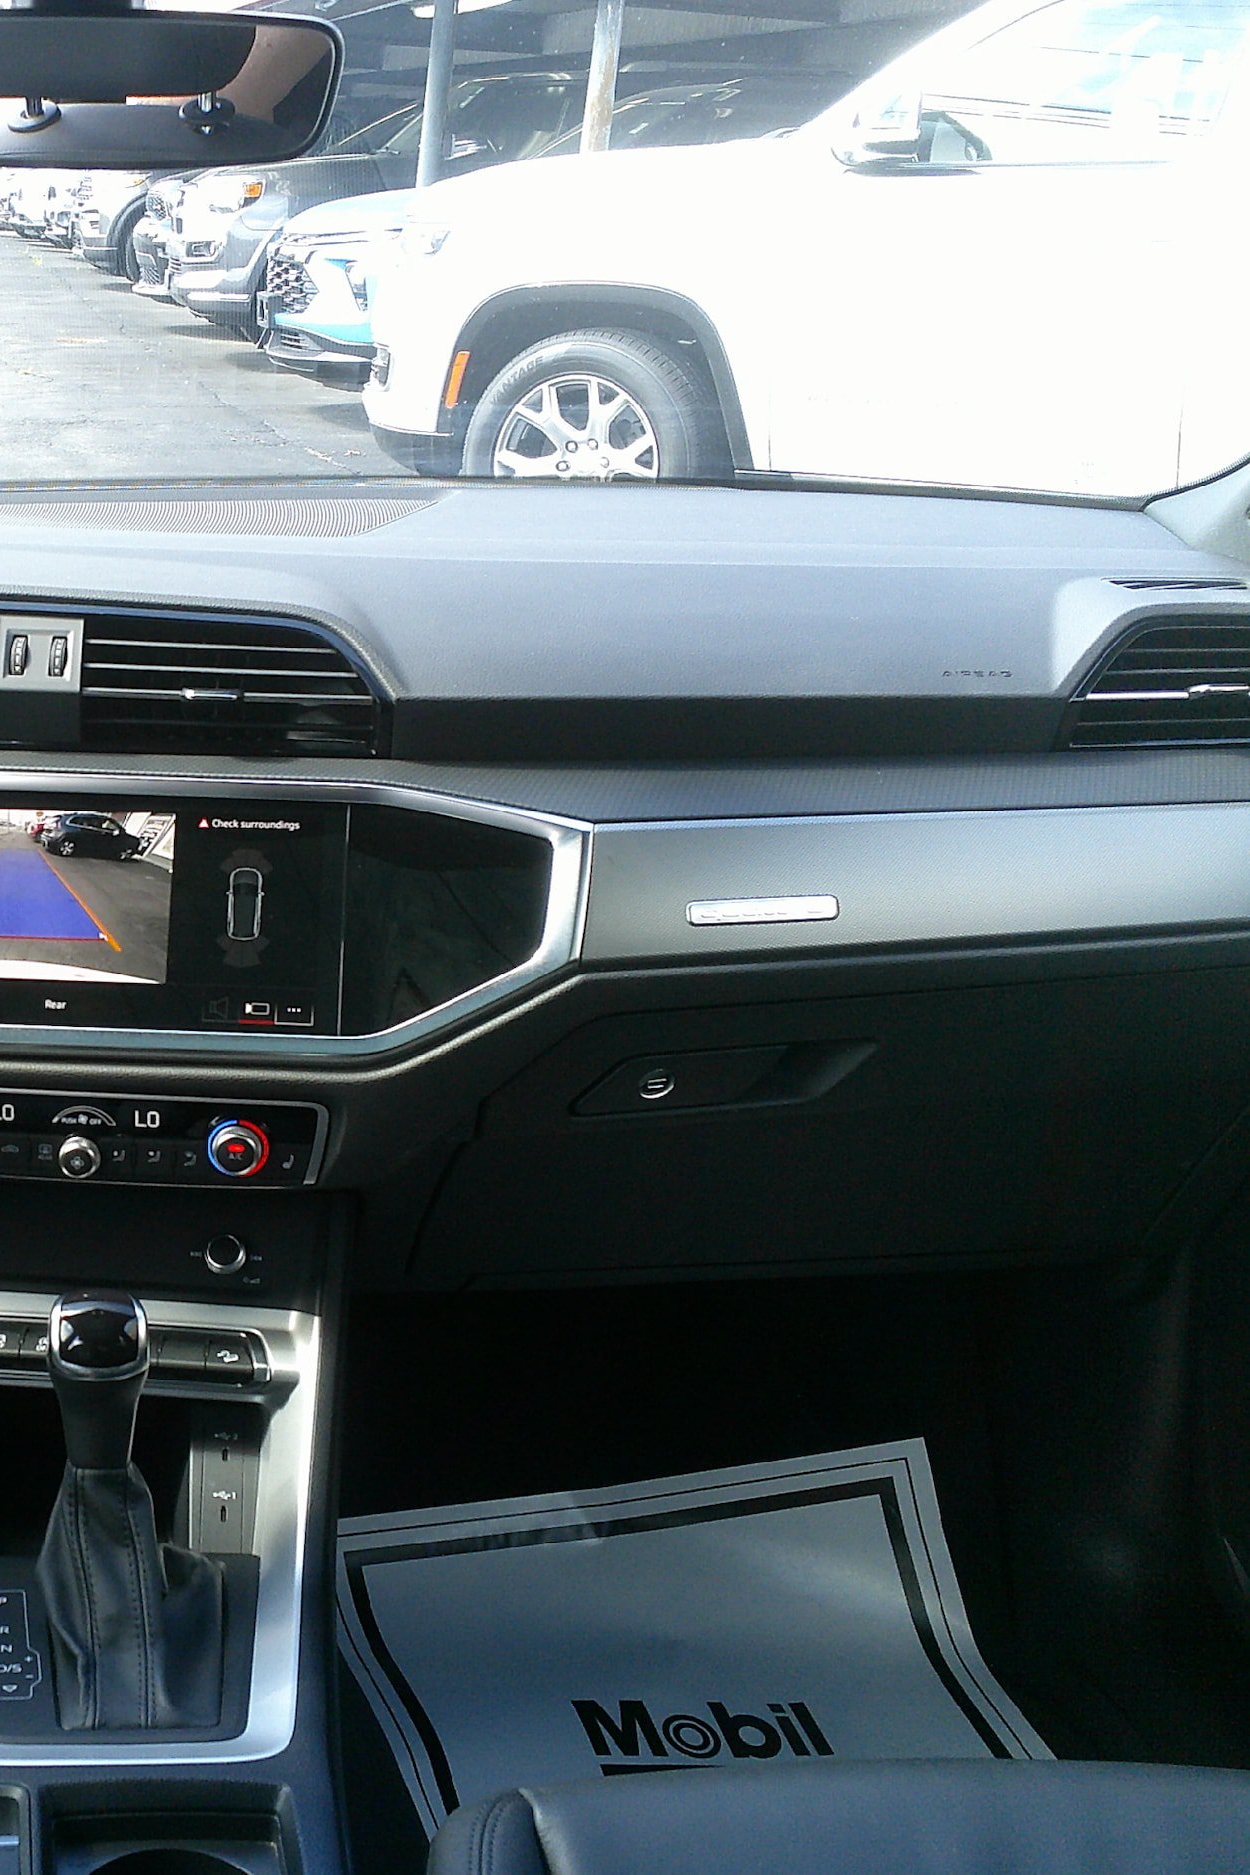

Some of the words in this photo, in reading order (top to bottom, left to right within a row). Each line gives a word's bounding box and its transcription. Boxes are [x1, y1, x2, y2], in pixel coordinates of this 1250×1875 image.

[211, 819, 237, 829] Check
[240, 821, 300, 831] surroundings
[45, 999, 66, 1009] Rear
[134, 1110, 160, 1128] LO
[0, 1626, 9, 1634] R
[1, 1645, 12, 1653] N
[571, 1700, 835, 1759] Mobil
